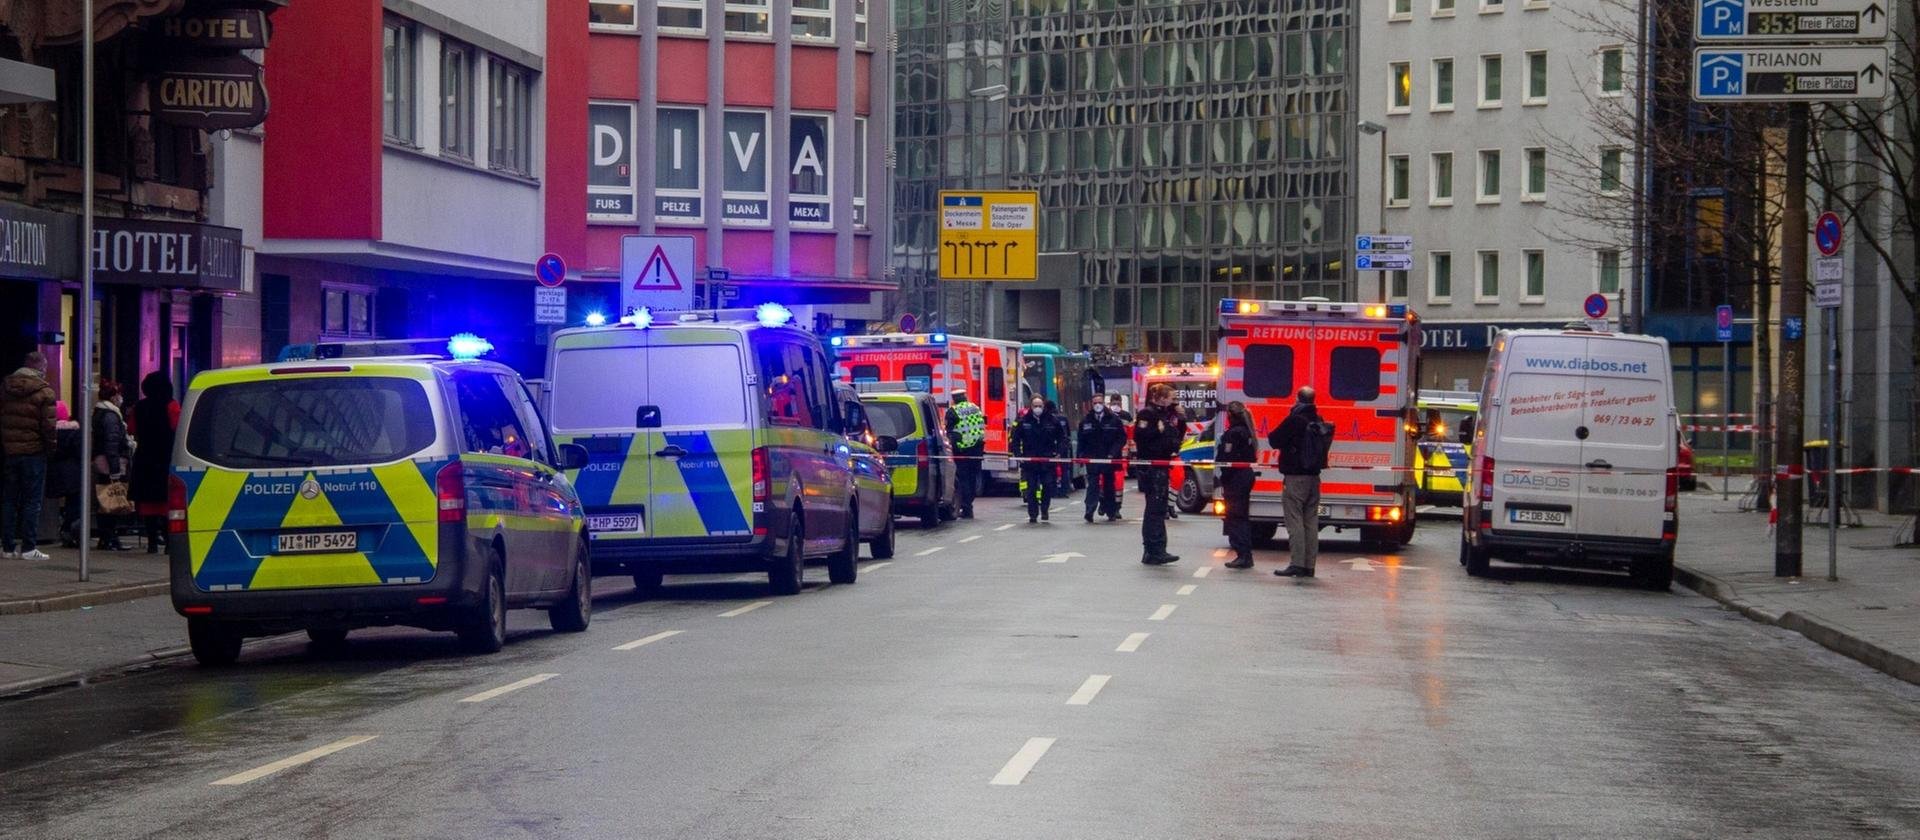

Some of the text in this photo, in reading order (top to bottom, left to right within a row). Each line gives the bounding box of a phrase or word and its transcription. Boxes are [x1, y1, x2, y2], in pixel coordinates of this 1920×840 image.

[164, 18, 254, 38] HOTEL
[1758, 14, 1796, 34] 353
[1800, 15, 1856, 29] freie Plätze
[1748, 52, 1823, 67] TRIANON
[1784, 74, 1795, 94] 3
[1797, 76, 1855, 89] freie Plätze
[160, 78, 254, 109] CARLTON
[595, 199, 622, 209] FURS
[662, 201, 691, 212] PELZE
[991, 205, 1028, 213] Palmengarten
[793, 206, 821, 218] MEXA
[92, 229, 198, 275] HOTEL
[1252, 327, 1375, 341] RETTUNGSDIENST
[1420, 329, 1468, 348] OTEL
[854, 352, 928, 362] RETTUNGSDIENST
[1526, 357, 1648, 374] www.diabos.net
[1174, 389, 1217, 399] ERWEHR
[1179, 400, 1202, 409] FURT
[1590, 396, 1627, 408] Frankfurt
[1626, 394, 1657, 406] gesucht
[1594, 414, 1610, 424] 069
[1618, 415, 1630, 425] 73
[680, 460, 719, 469] Notruf 110
[244, 484, 295, 495] POLIZEI
[324, 480, 377, 492] Notruf 110
[599, 517, 611, 528] HP
[613, 517, 636, 528] 5597
[1544, 512, 1562, 522] 360
[280, 534, 355, 550] WI HP 5492
